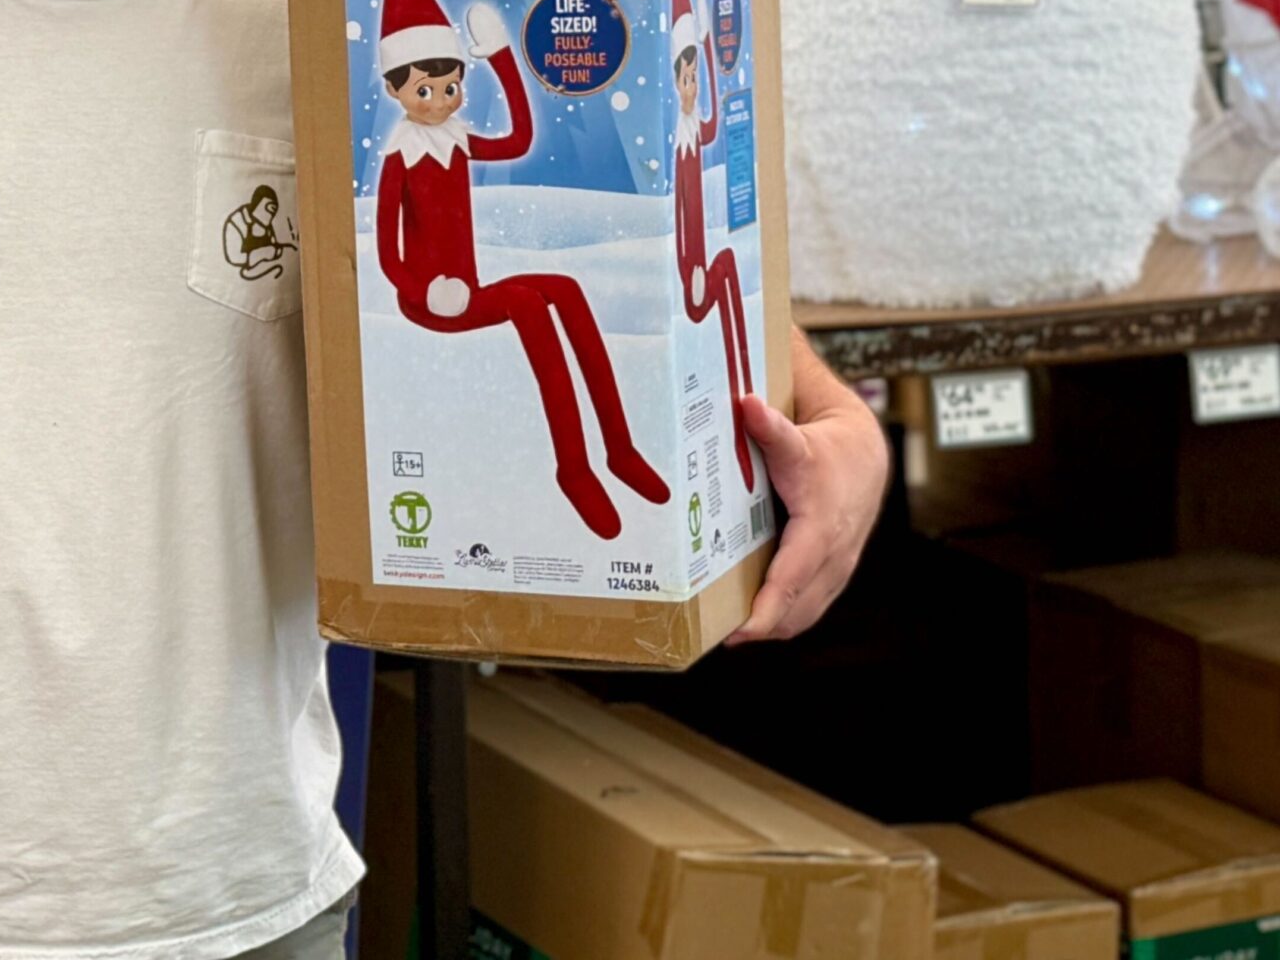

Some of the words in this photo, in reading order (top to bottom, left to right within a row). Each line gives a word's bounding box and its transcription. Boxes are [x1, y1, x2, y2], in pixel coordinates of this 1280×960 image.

[550, 16, 597, 33] SIZED!
[544, 52, 607, 68] POSEABLE
[562, 69, 591, 83] FUN!
[611, 561, 641, 574] ITEM
[645, 563, 653, 575] #
[606, 577, 660, 592] 1246384
